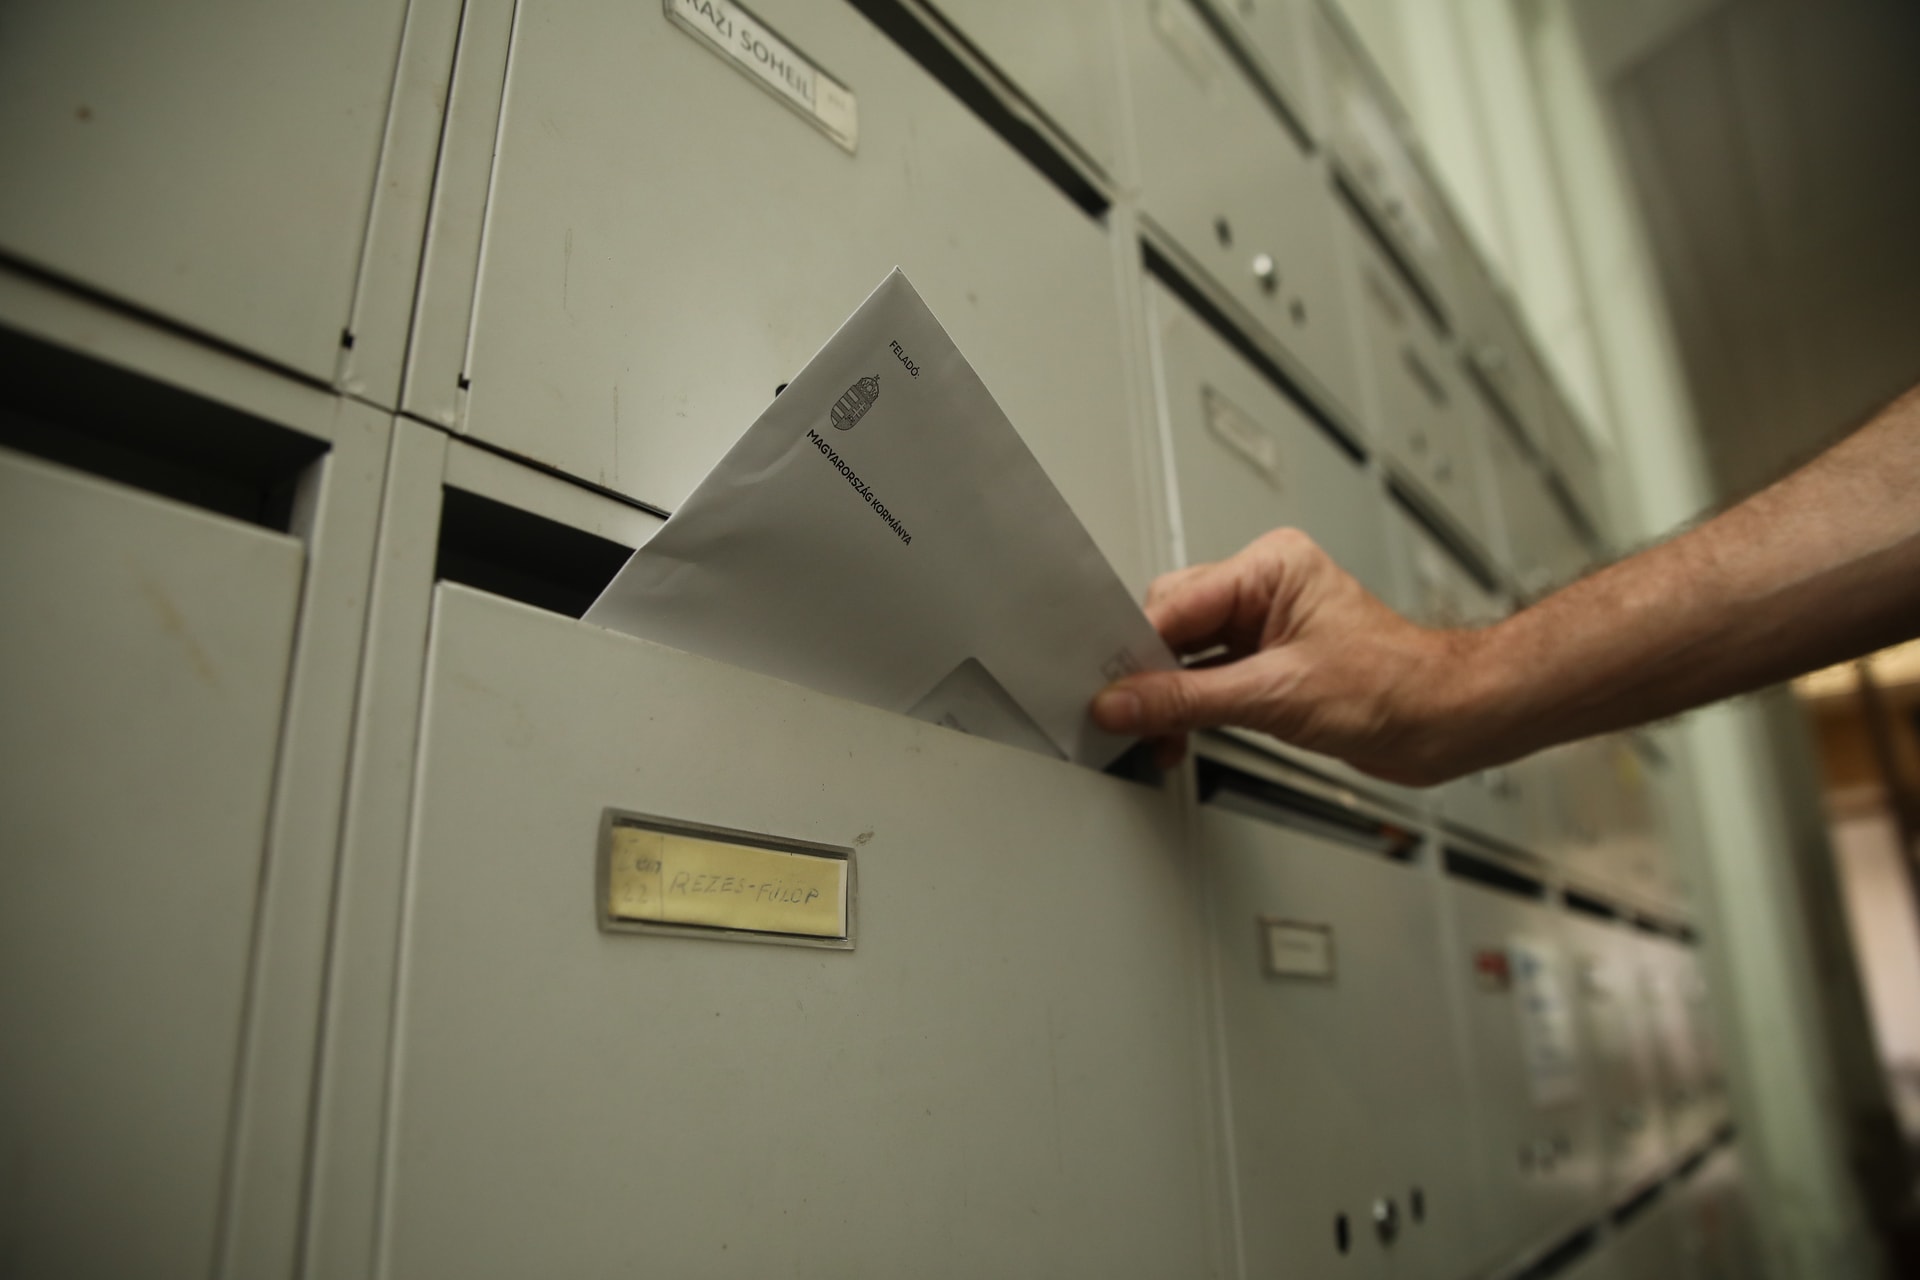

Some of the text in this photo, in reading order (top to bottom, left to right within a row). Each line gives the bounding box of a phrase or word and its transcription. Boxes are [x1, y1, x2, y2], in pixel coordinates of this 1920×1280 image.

[739, 29, 814, 101] SOHEIL
[889, 339, 920, 380] FELADÓ:
[806, 428, 912, 546] MAGYARORSZÁG KORMÁNYA
